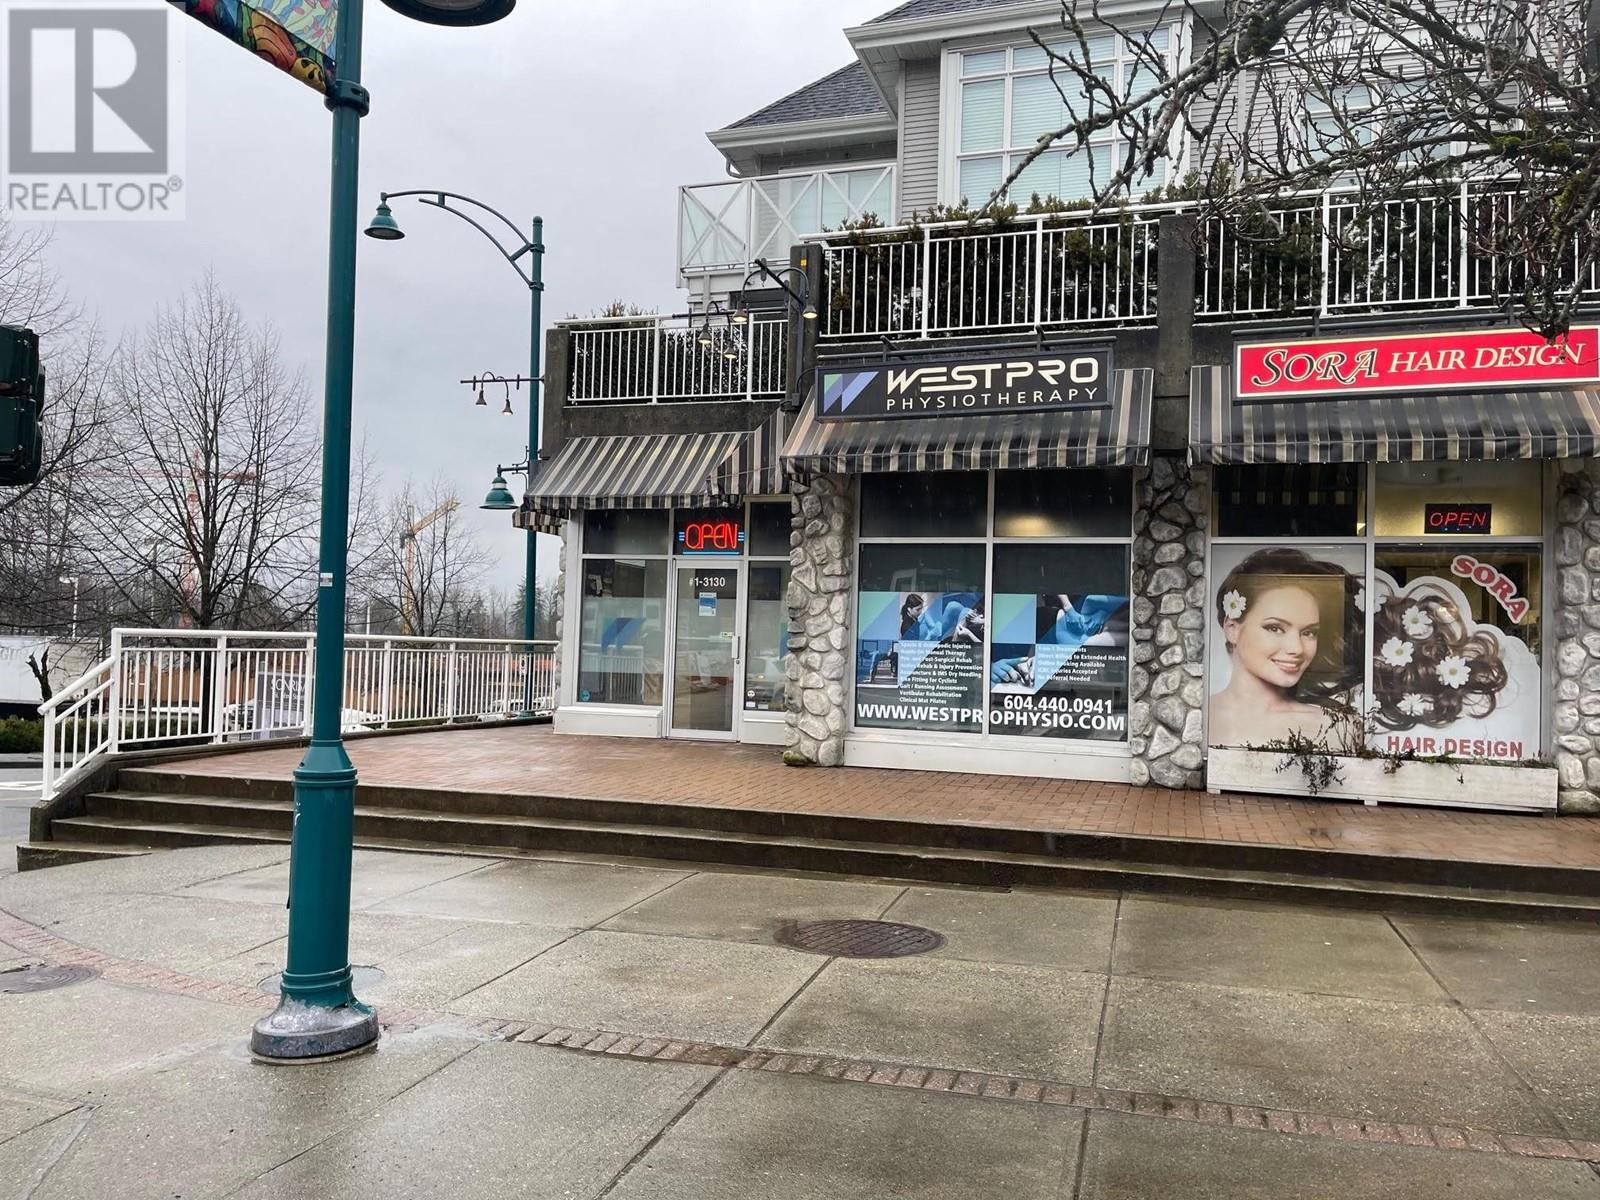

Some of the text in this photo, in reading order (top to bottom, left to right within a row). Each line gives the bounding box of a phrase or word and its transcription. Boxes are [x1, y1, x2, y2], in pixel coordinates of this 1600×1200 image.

[887, 357, 1099, 395] WESTPRO
[1251, 343, 1585, 387] SORA HAIR DESIGN
[886, 387, 1099, 411] PHYSIOTHERAPY
[1430, 512, 1487, 527] OPEN
[685, 523, 738, 549] OPEN
[1452, 557, 1528, 621] SORA
[1003, 695, 1112, 715] 604.440.0941
[1387, 736, 1523, 758] HAIR DESIGN
